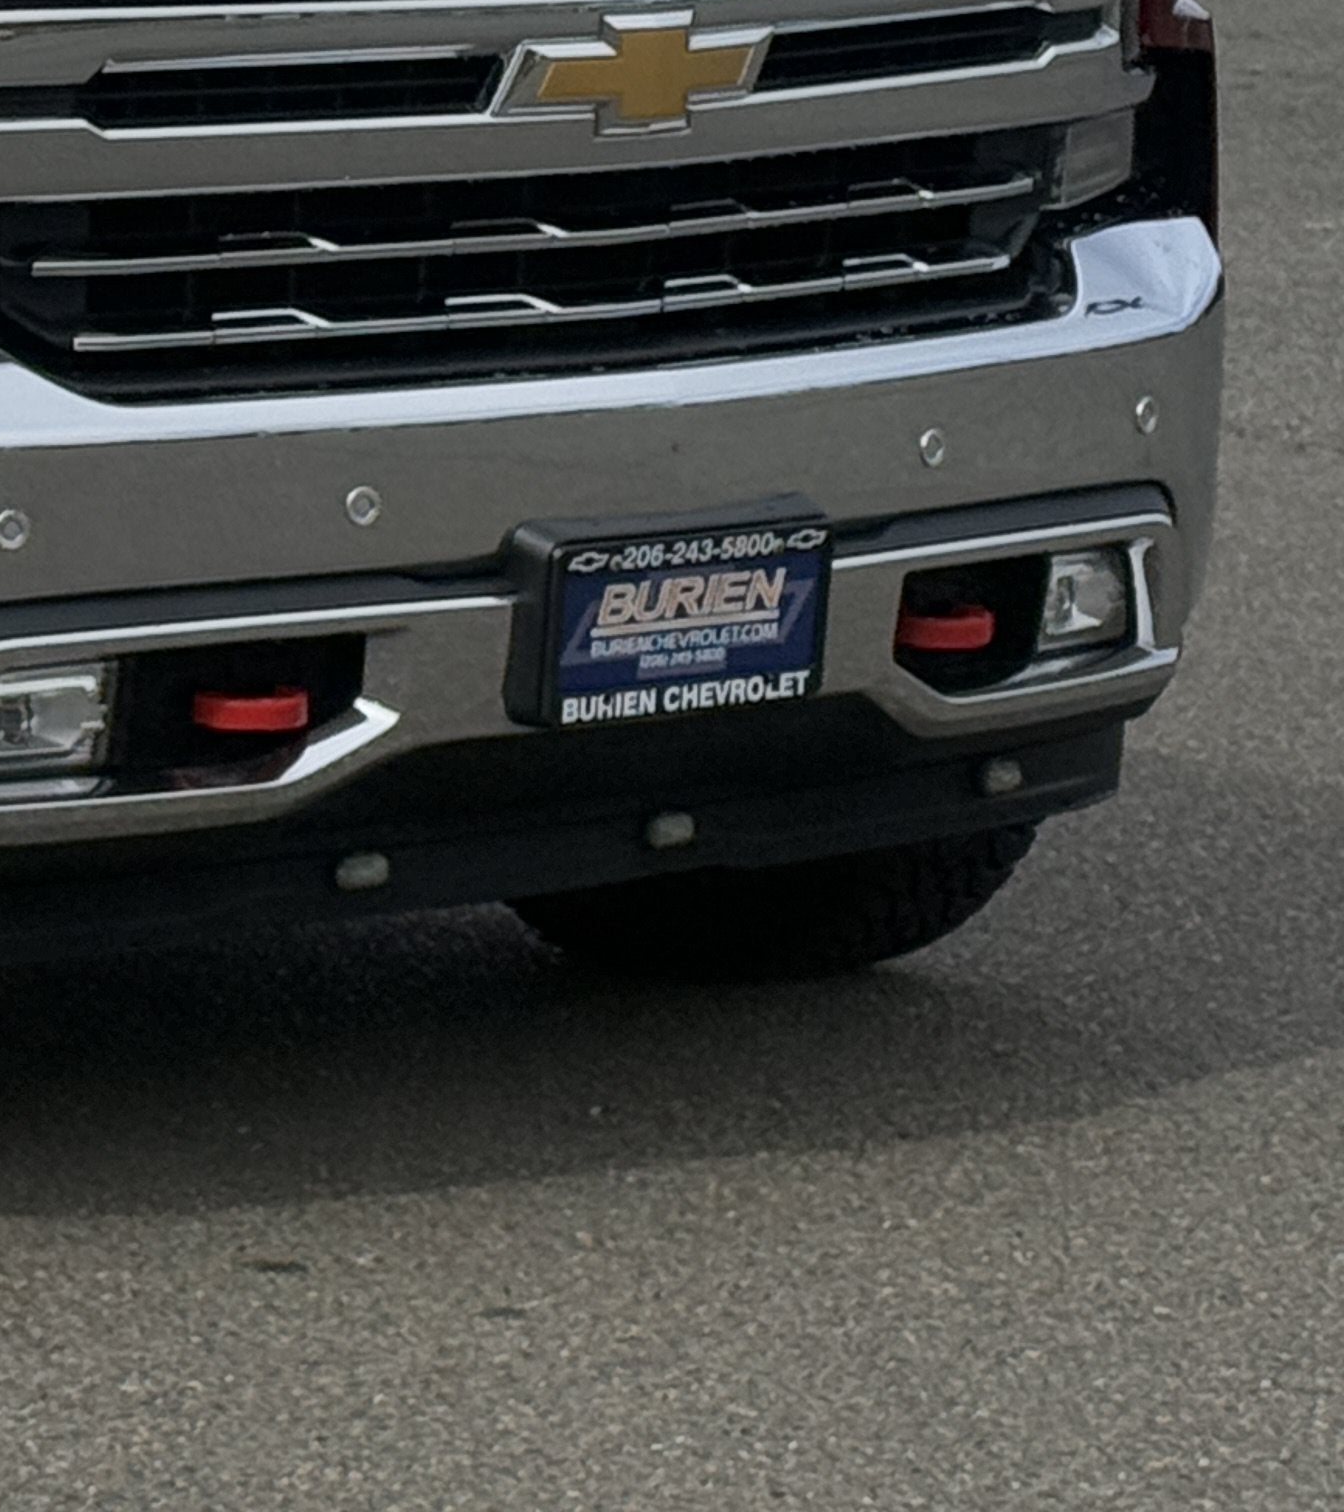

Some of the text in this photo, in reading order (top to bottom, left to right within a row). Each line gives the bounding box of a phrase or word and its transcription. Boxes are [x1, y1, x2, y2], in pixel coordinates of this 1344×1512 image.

[622, 532, 775, 570] 206-243-5800
[597, 567, 786, 625] BURIEN
[662, 669, 812, 713] CHEVROLET
